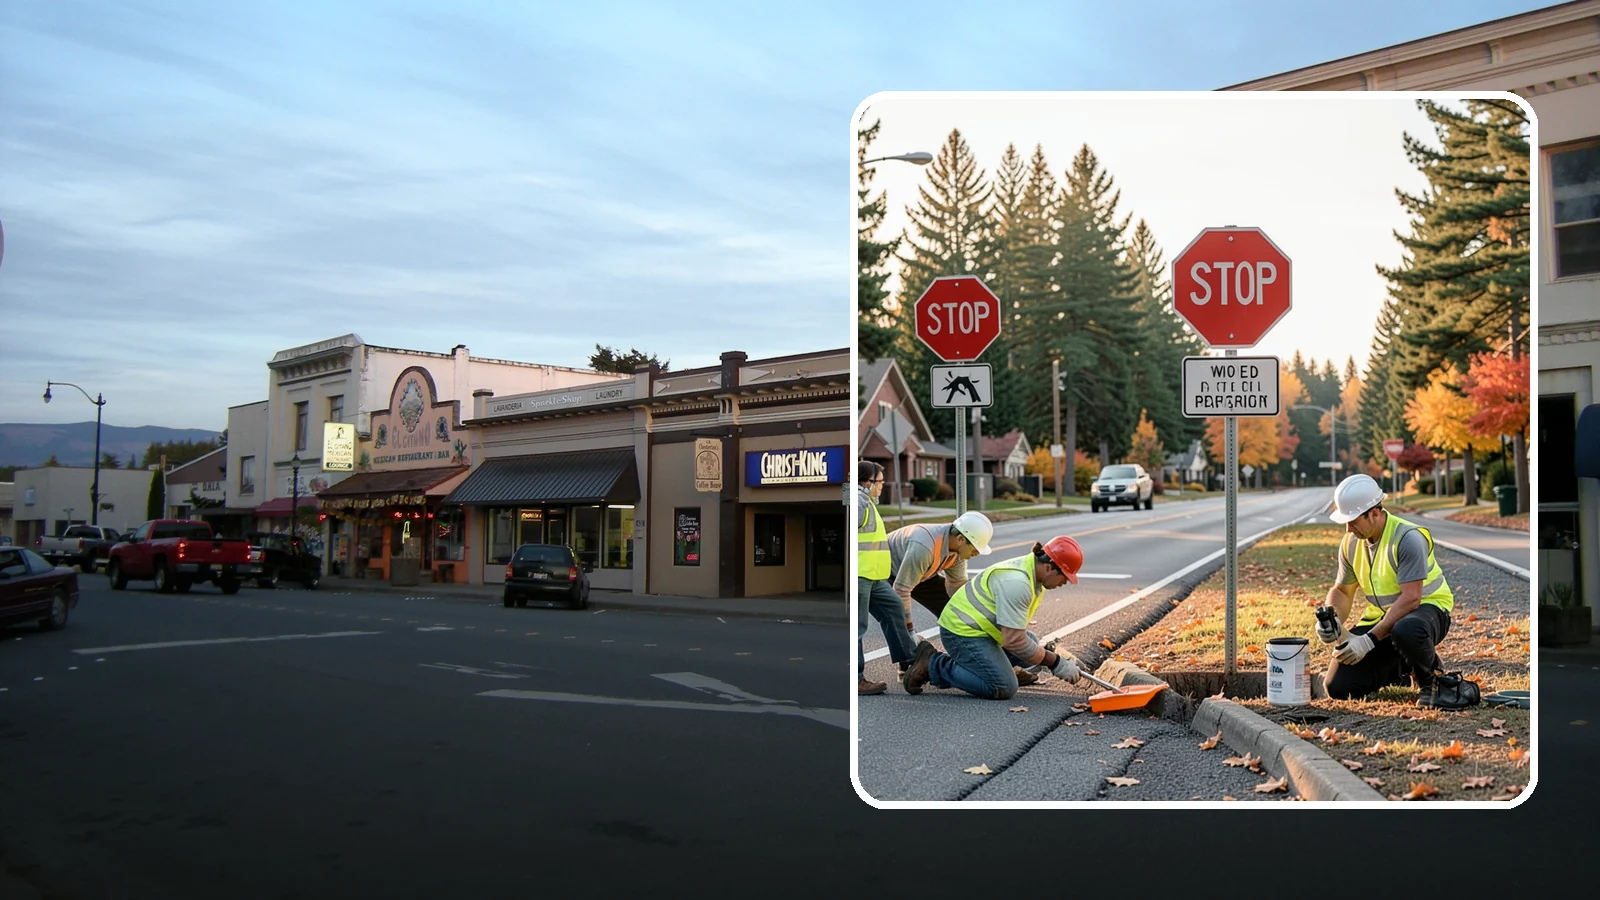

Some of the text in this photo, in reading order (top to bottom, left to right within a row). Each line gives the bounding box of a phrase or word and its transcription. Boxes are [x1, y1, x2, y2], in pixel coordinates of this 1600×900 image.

[1190, 261, 1277, 306] STOP
[927, 301, 990, 335] STOP
[595, 389, 624, 400] LAUNDRY
[493, 402, 522, 412] LAVANDERIA
[373, 454, 396, 464] MEXICAN
[397, 451, 433, 462] RESTAURANT
[438, 450, 450, 459] BAR
[761, 449, 827, 478] CHRIST KING
